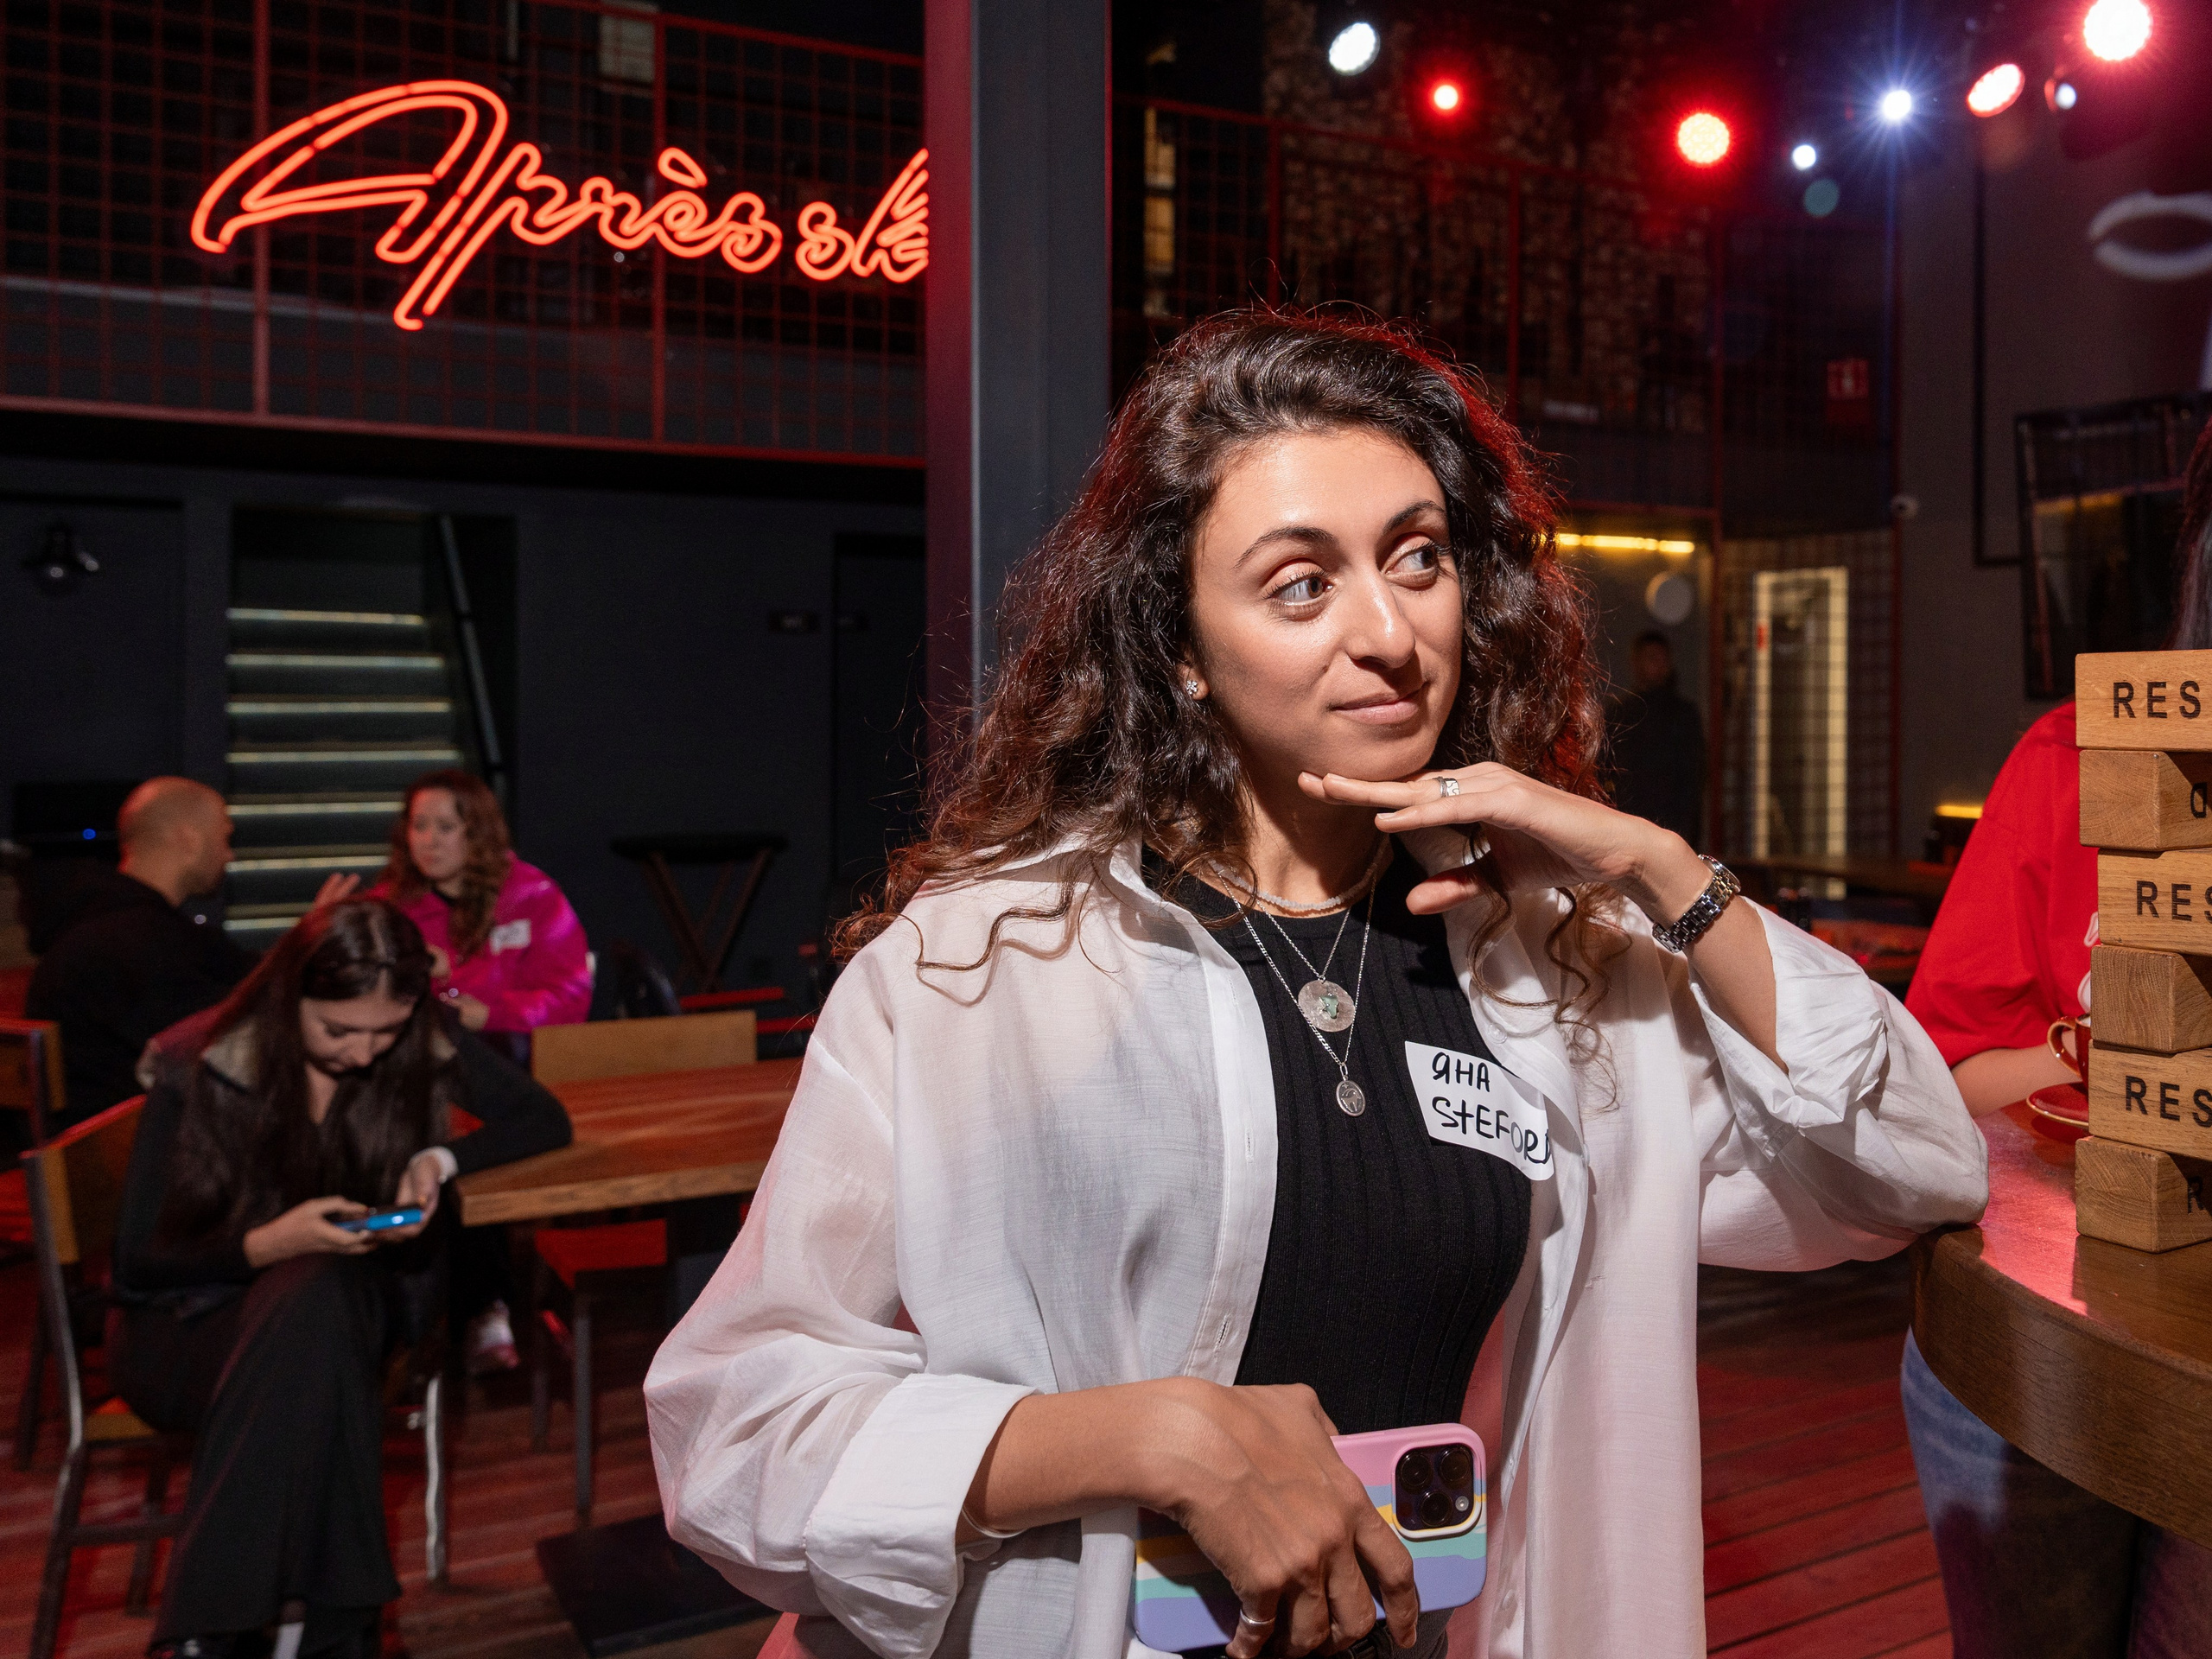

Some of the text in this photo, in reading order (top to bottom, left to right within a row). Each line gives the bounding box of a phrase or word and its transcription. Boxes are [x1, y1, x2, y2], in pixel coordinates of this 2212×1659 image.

[191, 79, 783, 331] Après
[2113, 680, 2202, 719] RES
[2125, 1075, 2212, 1128] RES
